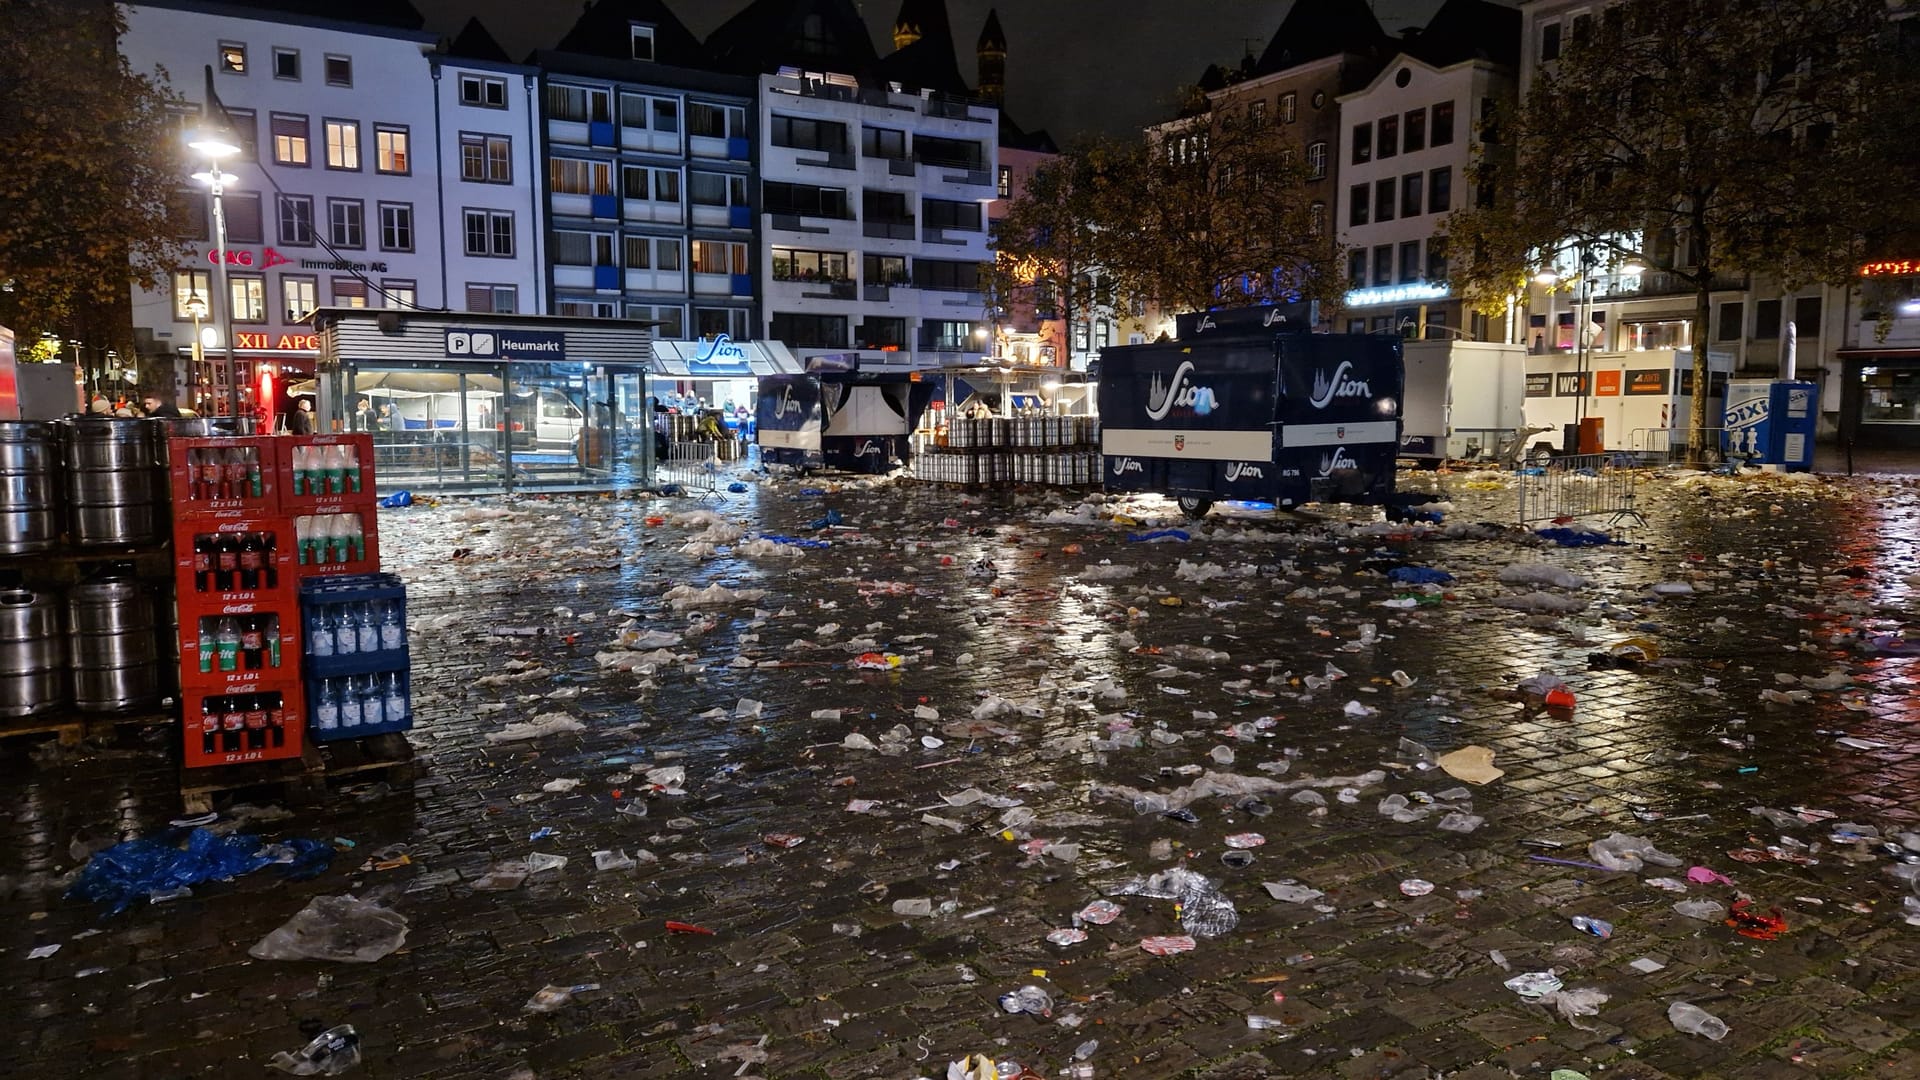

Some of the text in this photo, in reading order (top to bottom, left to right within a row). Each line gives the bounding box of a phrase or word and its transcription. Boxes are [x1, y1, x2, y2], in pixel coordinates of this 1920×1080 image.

[301, 258, 367, 272] Immobilien
[370, 260, 388, 273] AG
[237, 333, 269, 349] XII
[501, 339, 560, 352] Heumarkt
[696, 333, 745, 363] Sion
[1145, 360, 1220, 421] Sion
[1309, 360, 1373, 409] Sion
[1559, 376, 1579, 393] WC
[775, 384, 802, 419] Sion
[1725, 399, 1769, 426] DIXI
[1224, 462, 1264, 482] Sion
[1319, 446, 1358, 477] Sion
[226, 754, 235, 762] 12
